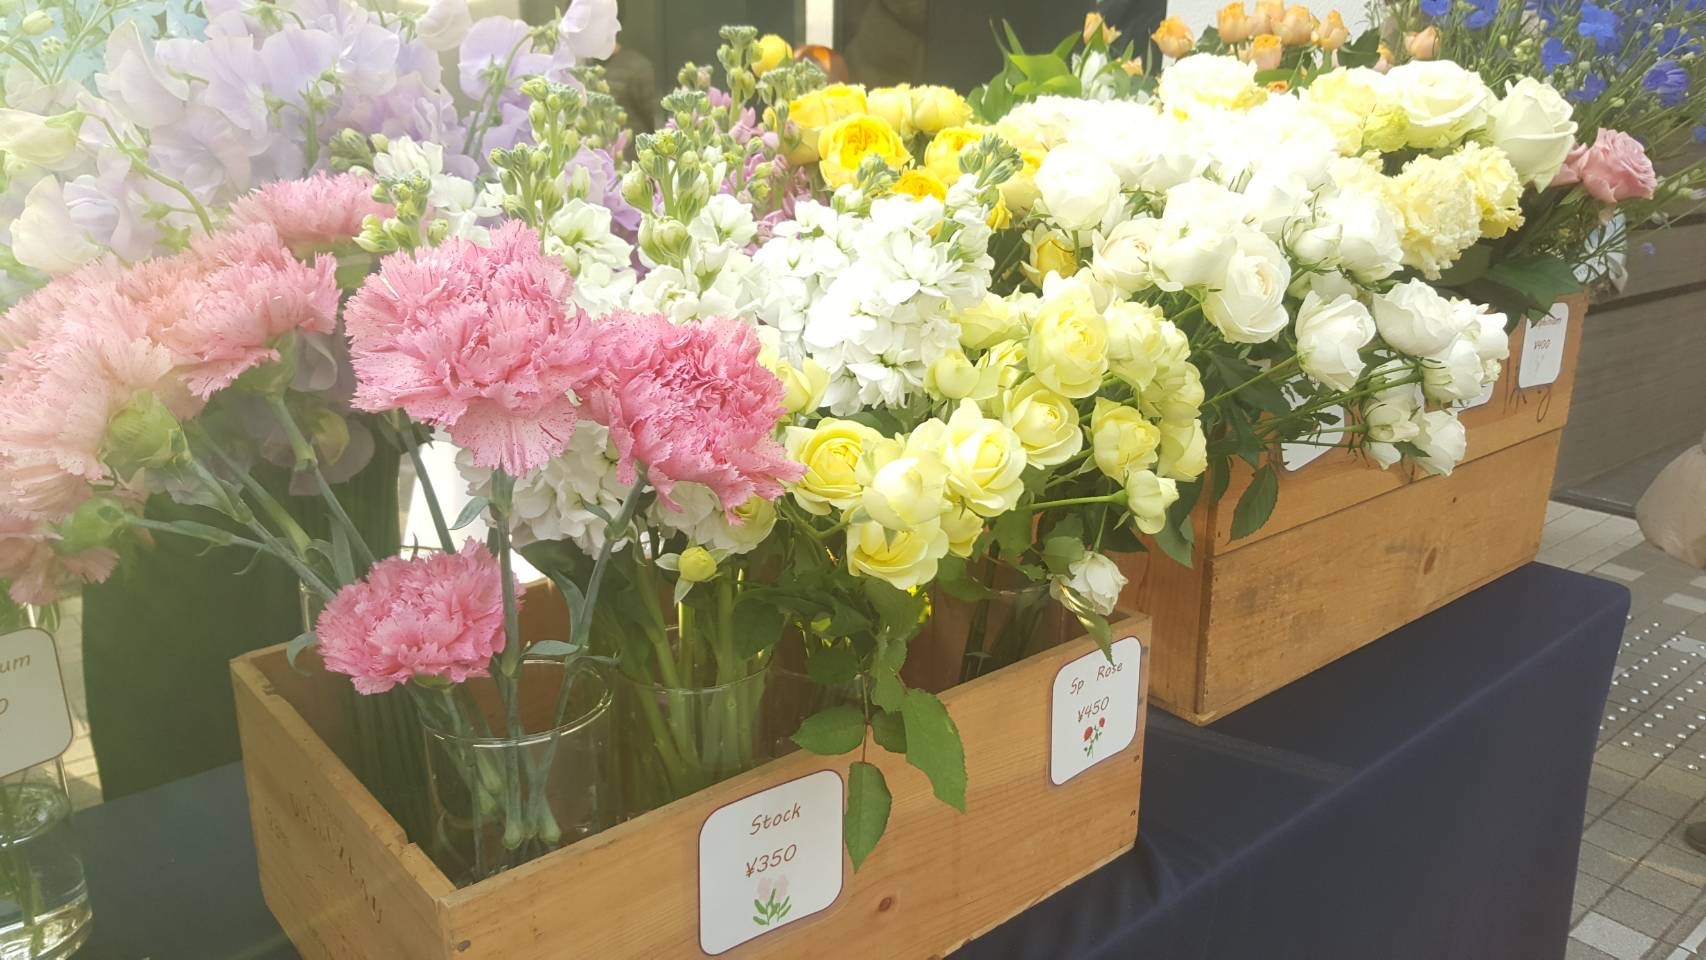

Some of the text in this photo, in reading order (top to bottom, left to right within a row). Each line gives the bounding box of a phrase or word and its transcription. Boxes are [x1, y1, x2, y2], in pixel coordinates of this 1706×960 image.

[1070, 662, 1124, 695] Sp Rose
[1077, 696, 1110, 723] ¥450
[749, 801, 801, 836] Stock
[745, 843, 798, 878] ¥350
